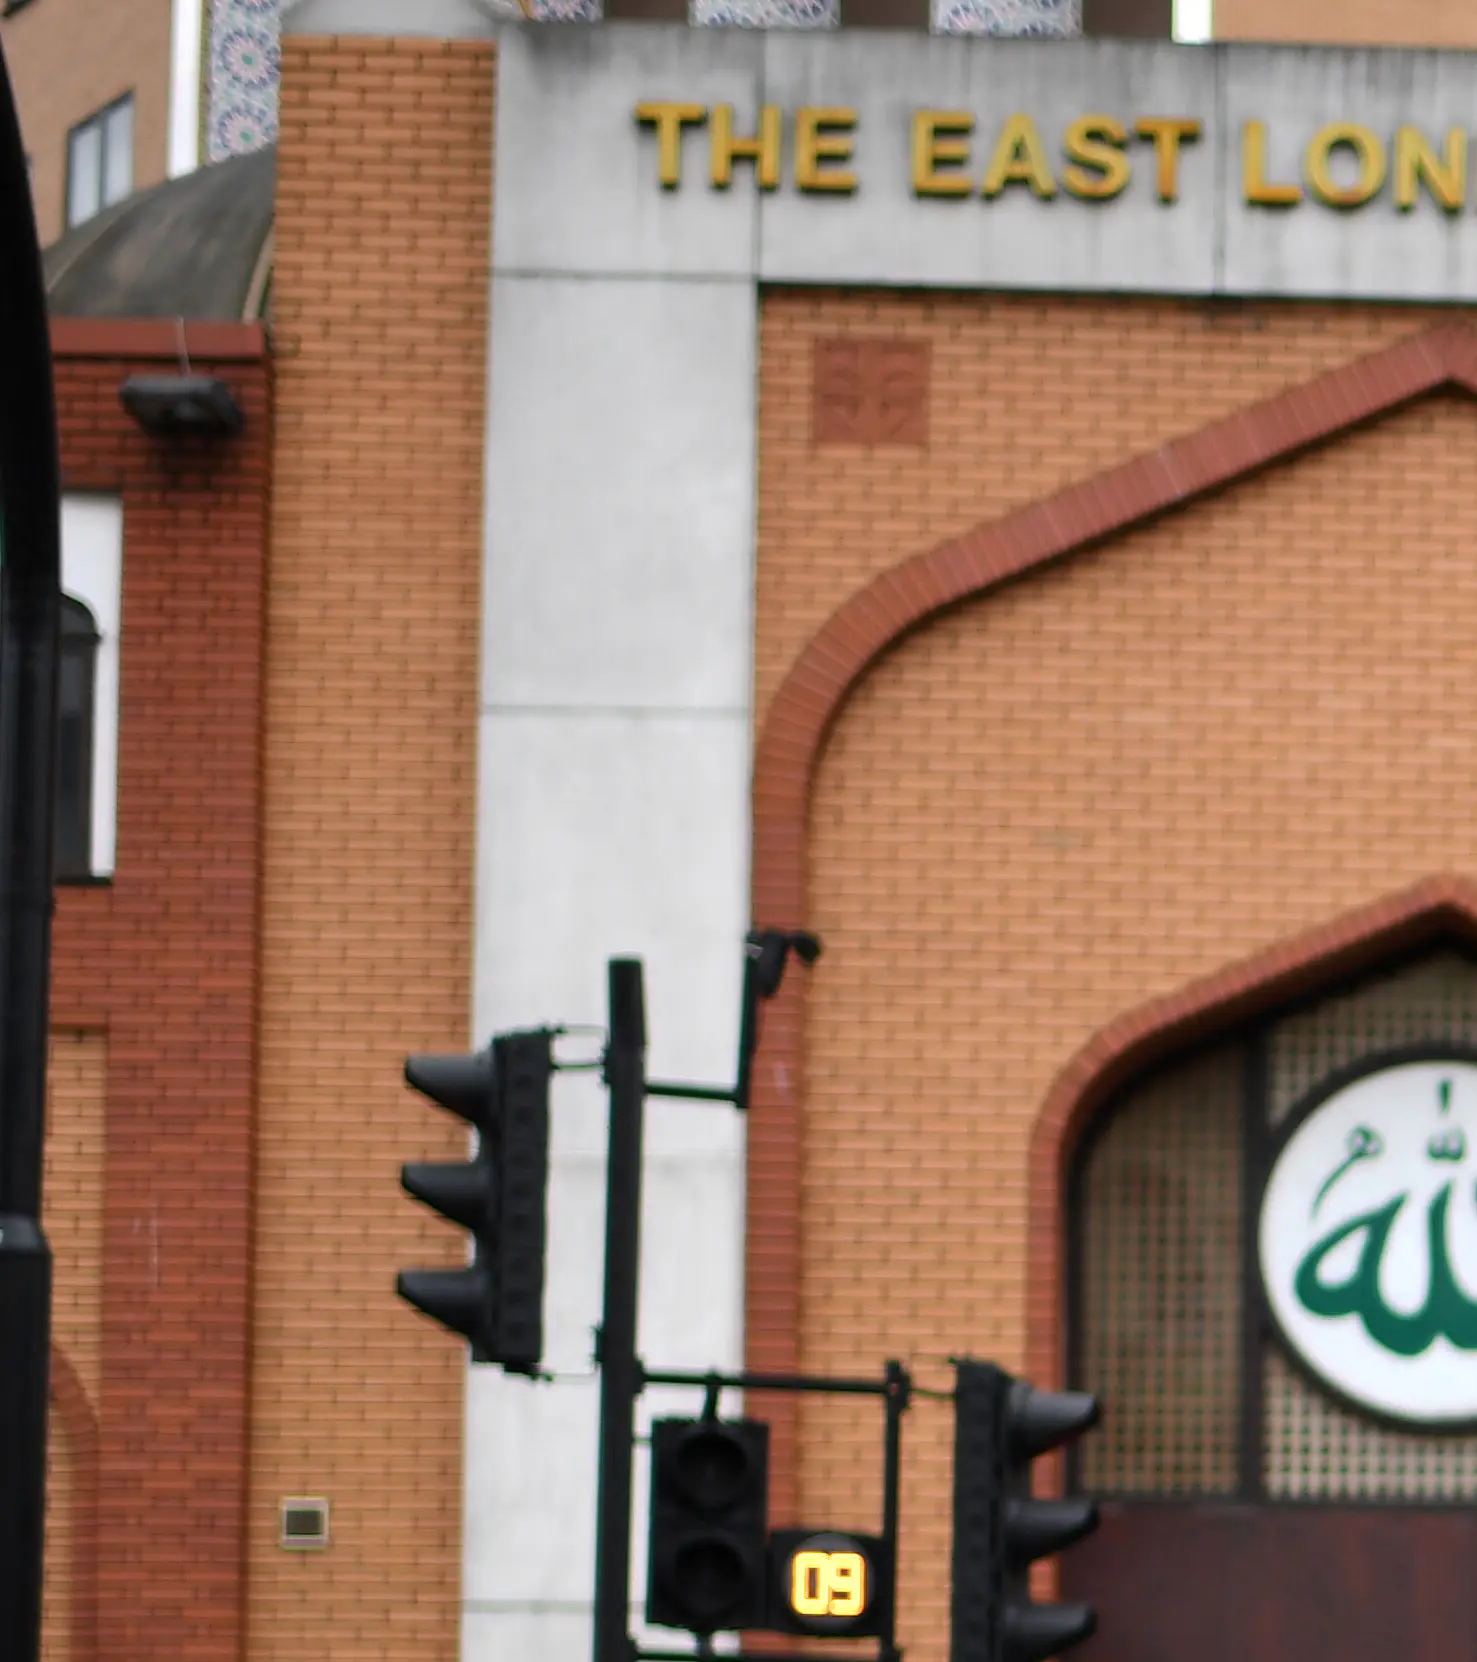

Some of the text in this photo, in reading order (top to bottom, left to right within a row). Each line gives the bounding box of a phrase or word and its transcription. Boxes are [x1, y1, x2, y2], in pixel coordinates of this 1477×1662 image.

[635, 102, 857, 190] THE
[913, 111, 1201, 204] EAST
[791, 1550, 867, 1617] 09
